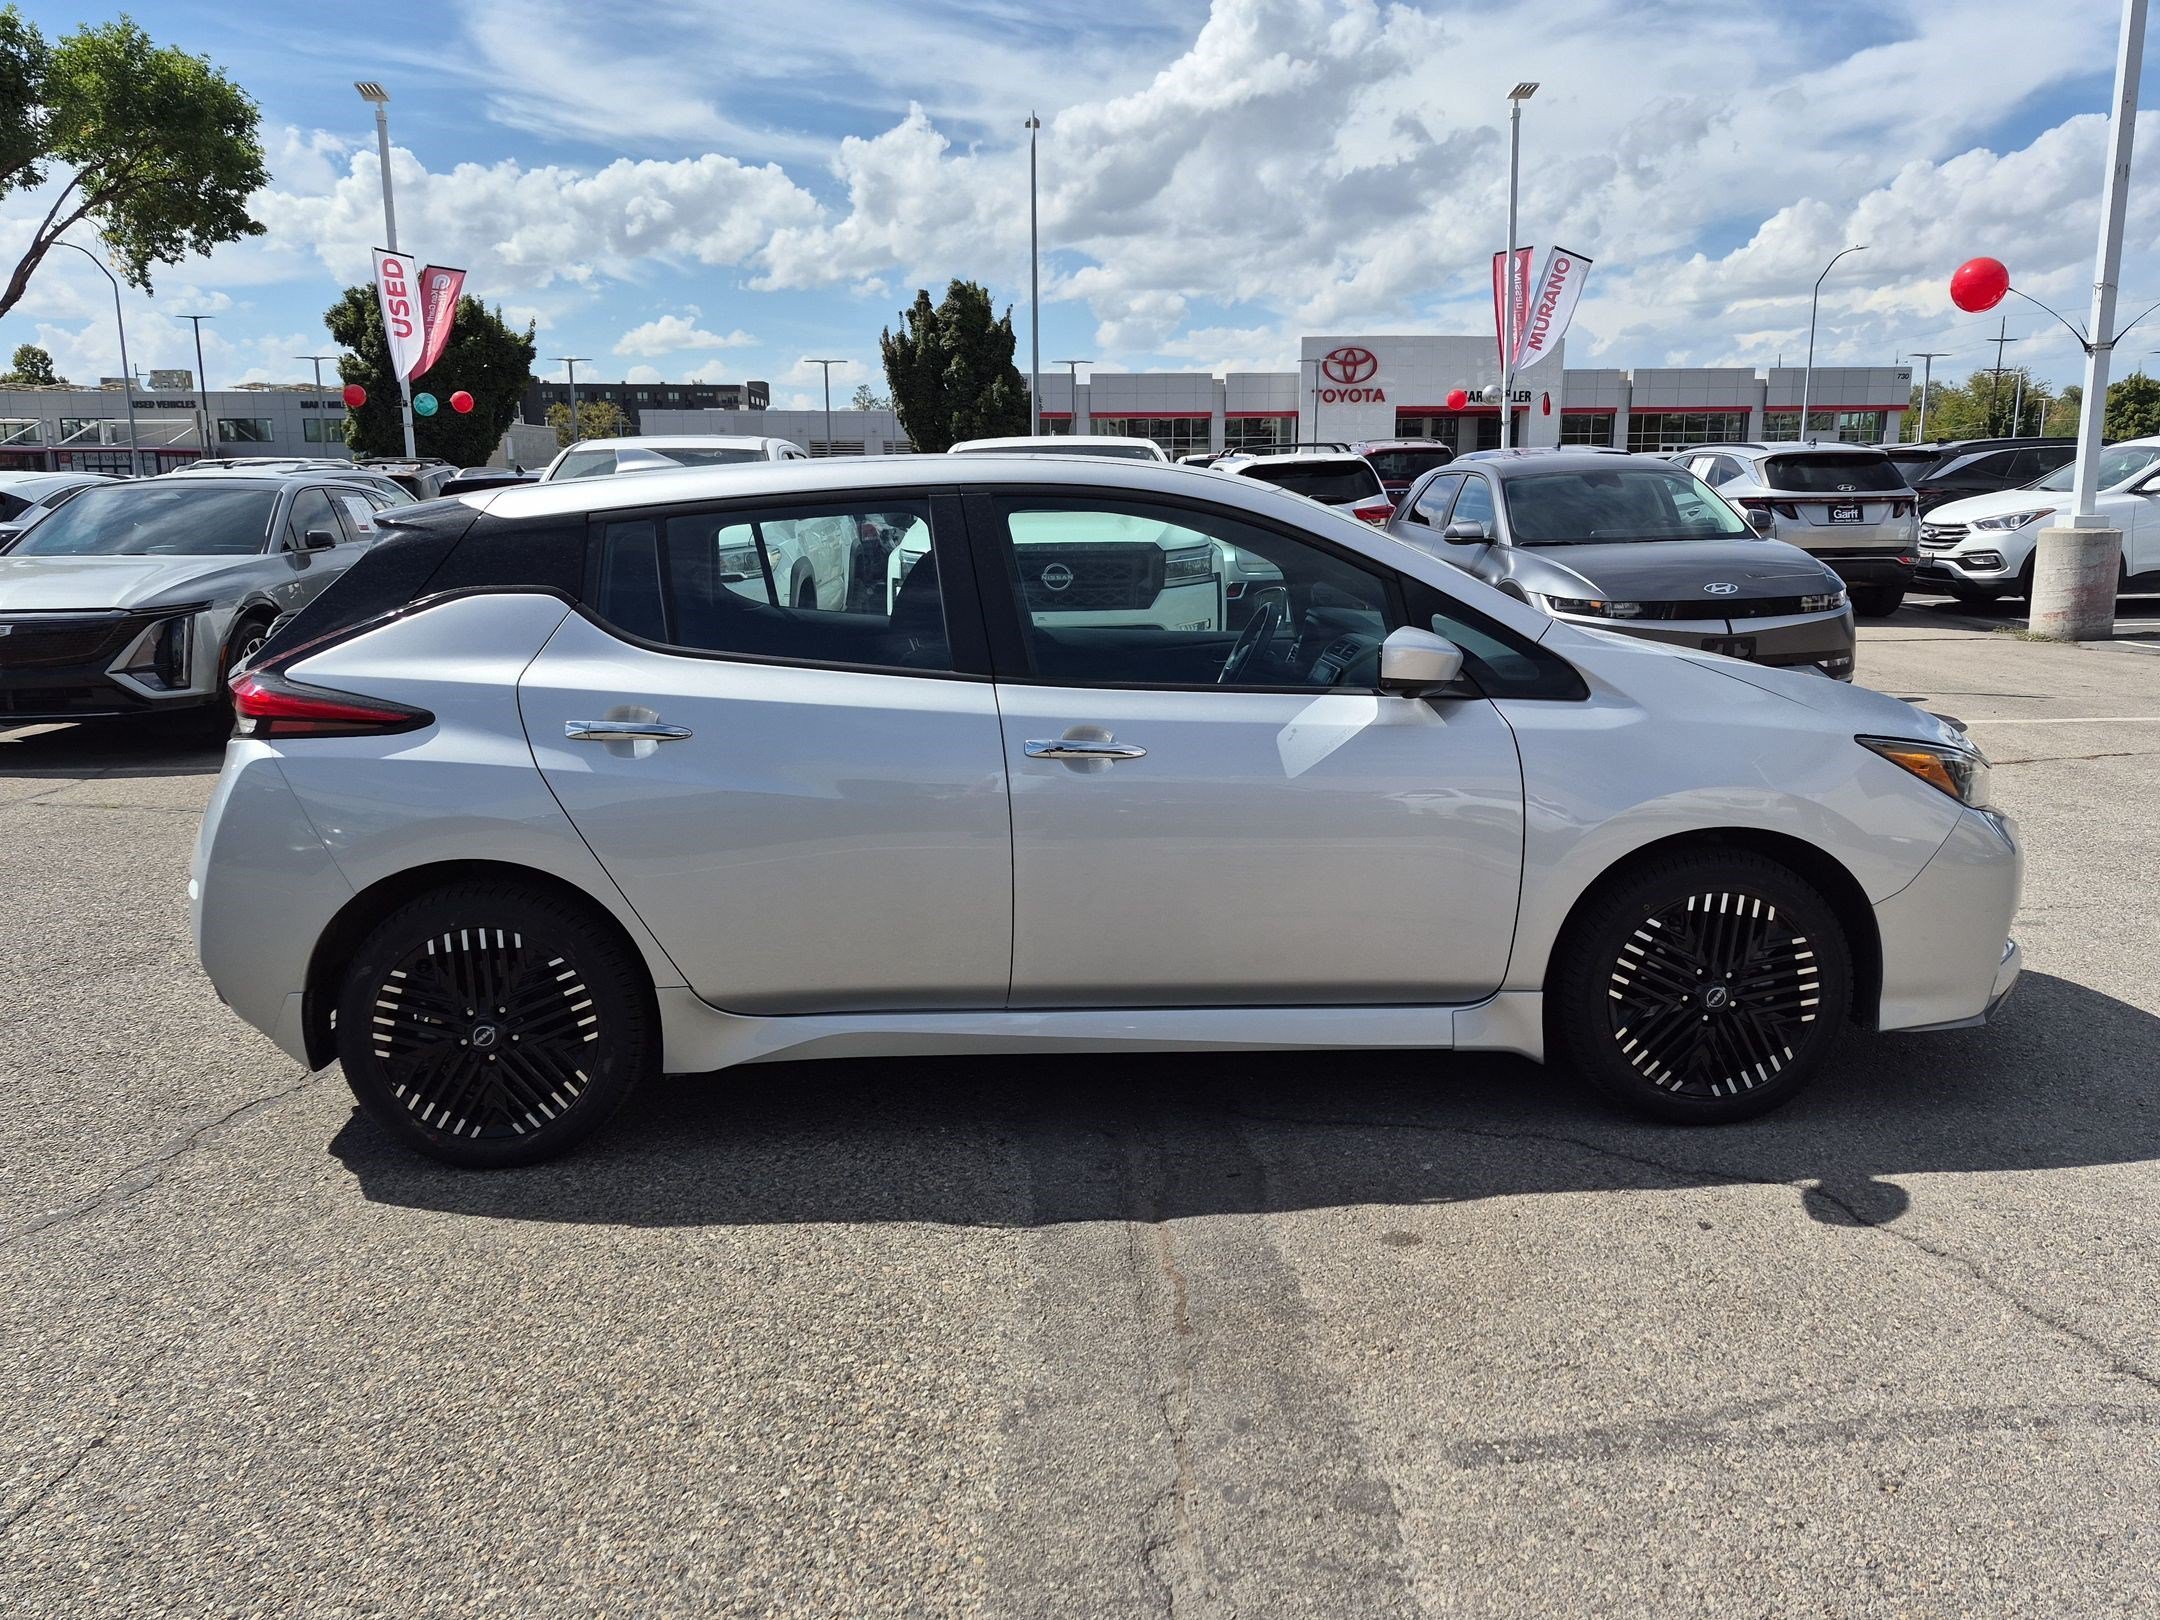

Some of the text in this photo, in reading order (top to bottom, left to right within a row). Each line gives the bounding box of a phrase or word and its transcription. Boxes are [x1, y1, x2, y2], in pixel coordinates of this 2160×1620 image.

[382, 258, 413, 338] USED
[1528, 257, 1571, 351] MURANO
[131, 400, 197, 409] USED VEHICLES
[1833, 509, 1859, 519] Garff
